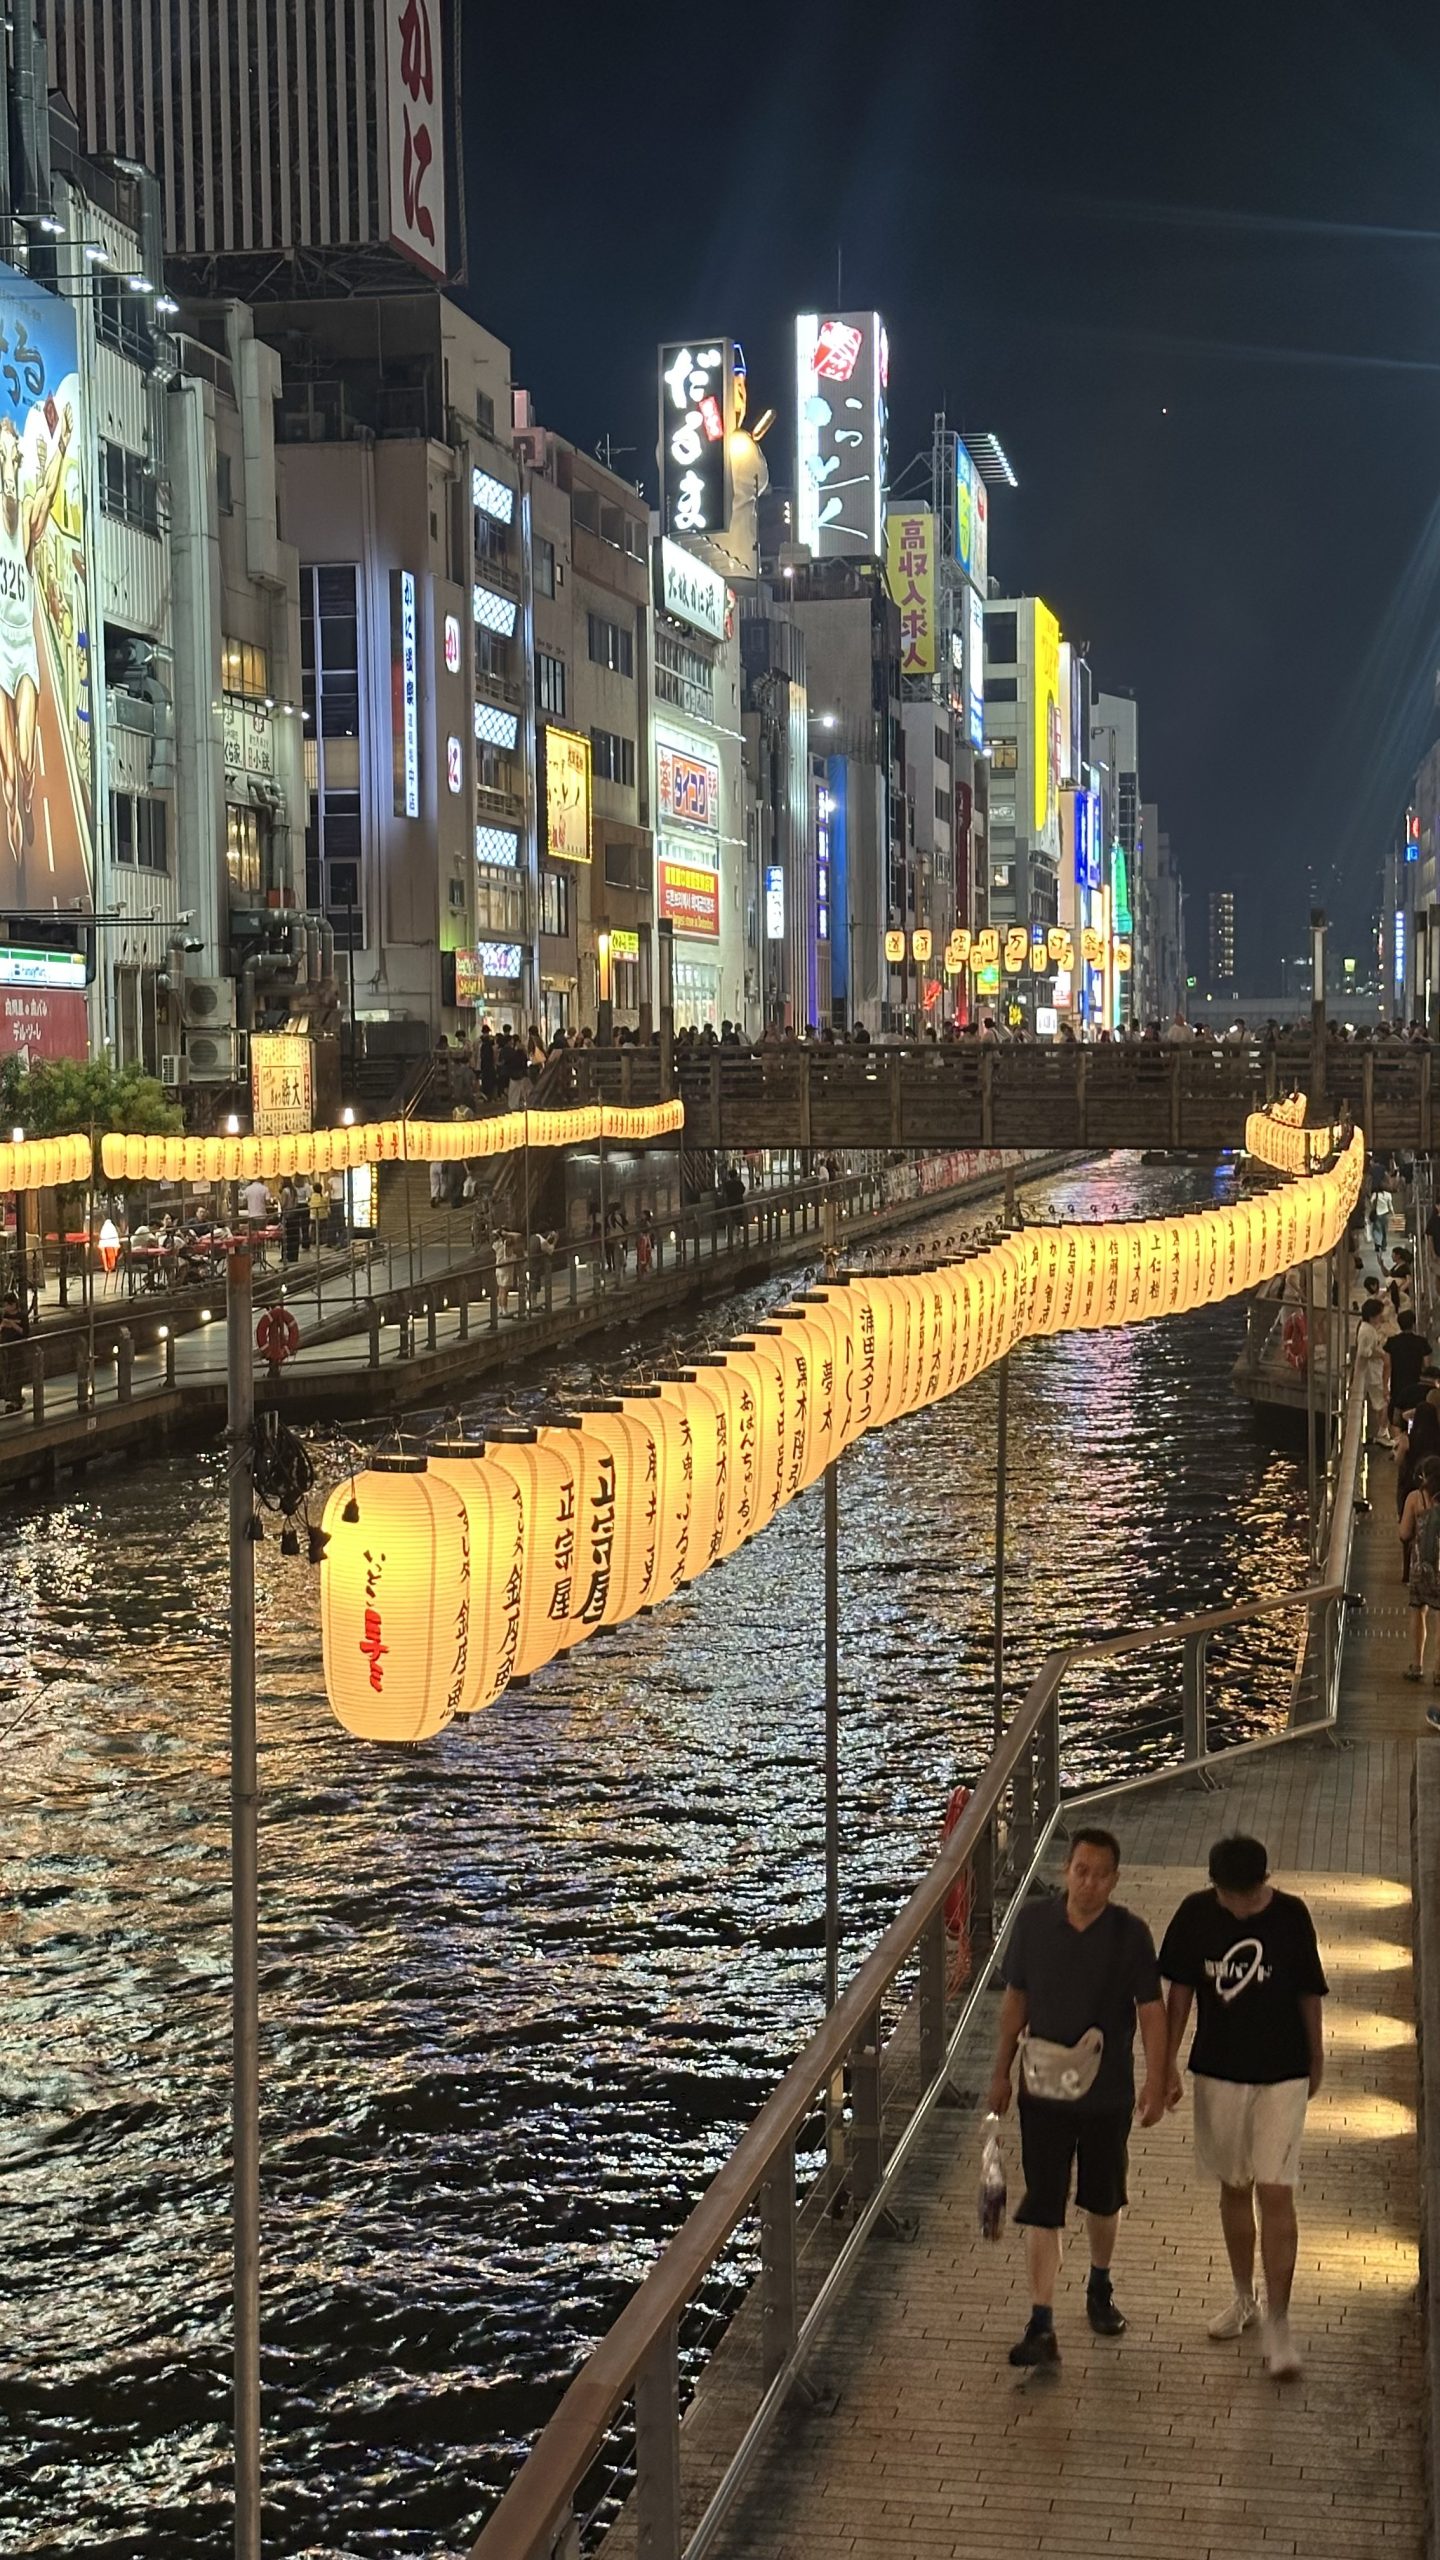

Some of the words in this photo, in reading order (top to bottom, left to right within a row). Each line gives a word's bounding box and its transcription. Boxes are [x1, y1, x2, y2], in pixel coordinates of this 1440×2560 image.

[664, 348, 722, 530] だるま
[898, 519, 928, 668] 高収入求人
[548, 1479, 574, 1620] 正宗屋
[569, 1453, 615, 1624] 正宗屋
